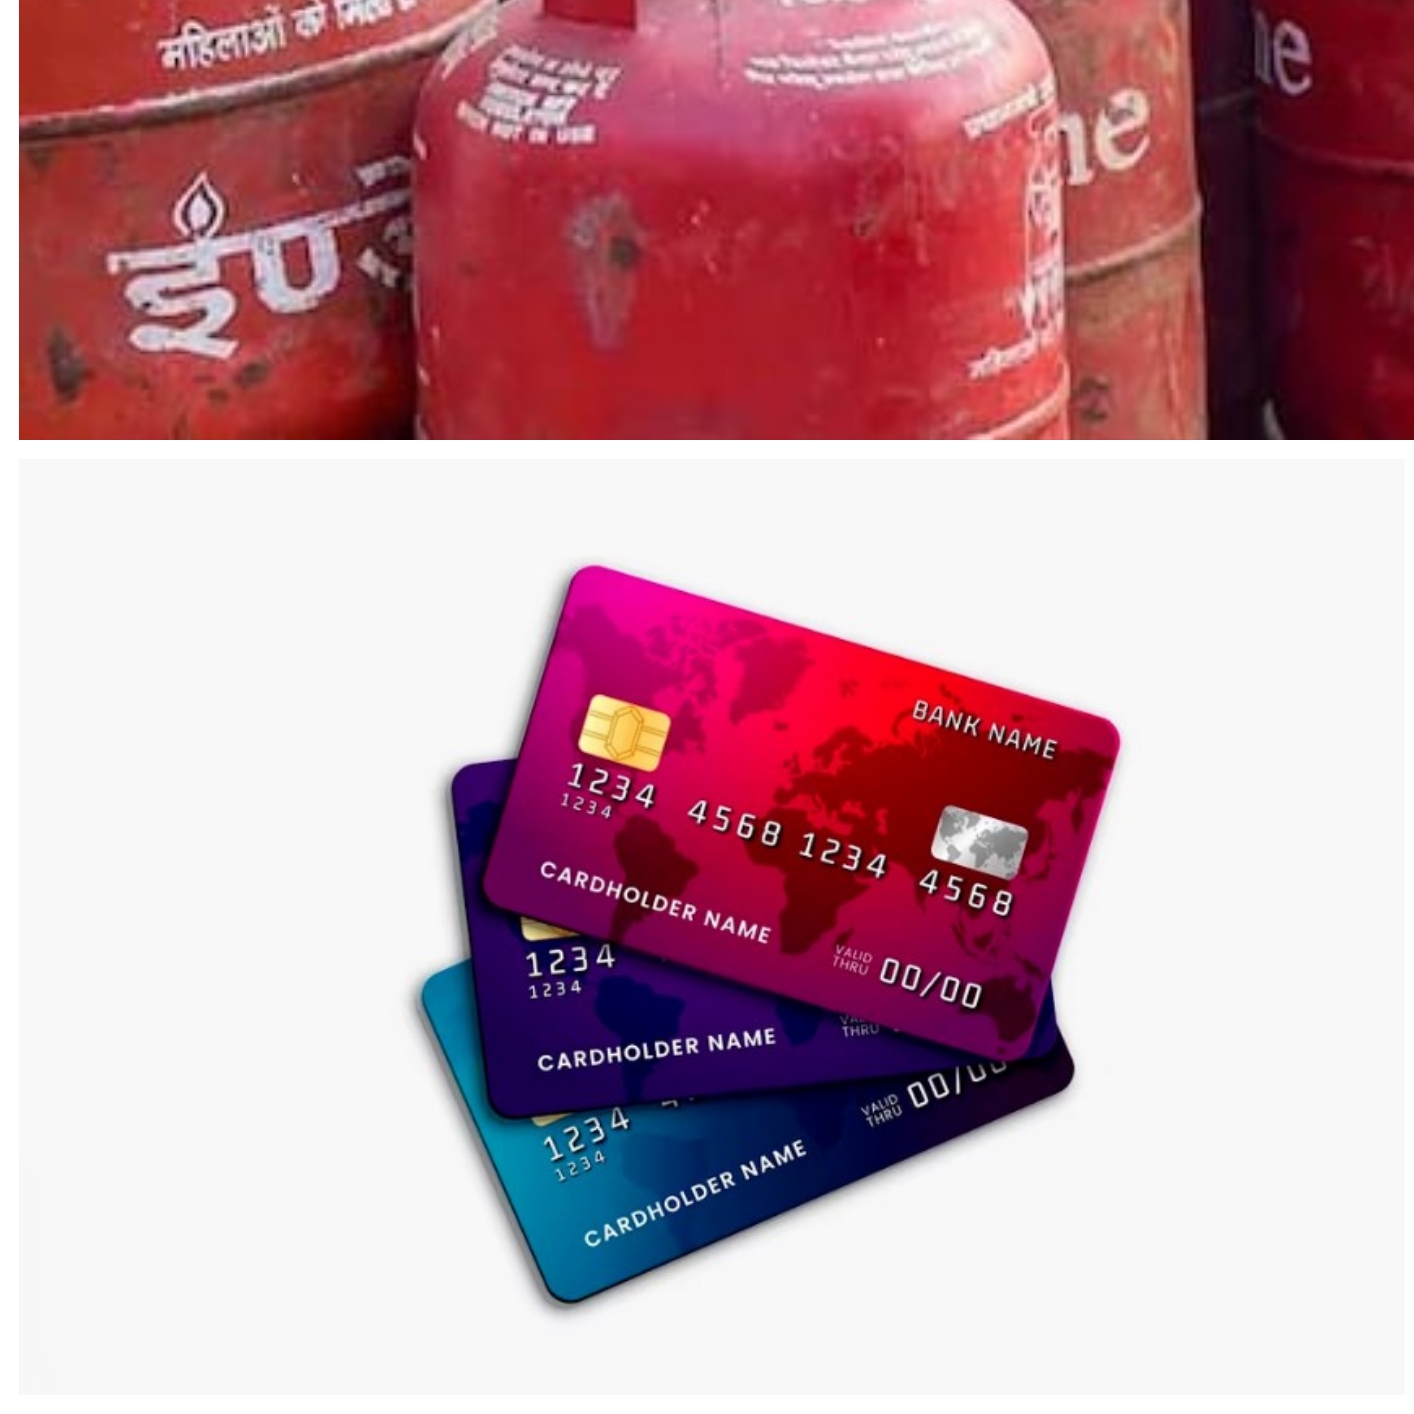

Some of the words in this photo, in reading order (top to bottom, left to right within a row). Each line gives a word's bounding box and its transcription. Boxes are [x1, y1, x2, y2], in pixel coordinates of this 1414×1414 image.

[912, 698, 981, 737] BANK
[987, 721, 1059, 761] NAME
[559, 792, 613, 820] 1234
[567, 762, 655, 809] 1234
[687, 799, 783, 847] 4568
[798, 832, 887, 879] 1234
[918, 869, 1013, 917] 4568
[539, 860, 698, 922] CARDHOLDER
[703, 909, 773, 945] NAME
[525, 943, 617, 978] 1234
[831, 954, 870, 977] THRU
[834, 943, 874, 964] VALID
[528, 979, 583, 1000] 1234
[878, 956, 983, 1010] 00/00
[841, 1023, 880, 1038] THRU
[536, 1037, 700, 1072] CARDHOLDER
[707, 1027, 777, 1052] NAME
[860, 1092, 899, 1117] VALID
[865, 1104, 904, 1128] THRU
[542, 1106, 631, 1163] 1234
[554, 1149, 606, 1183] 1234
[583, 1170, 736, 1249] CARDHOLDER
[739, 1139, 808, 1181] NAME
